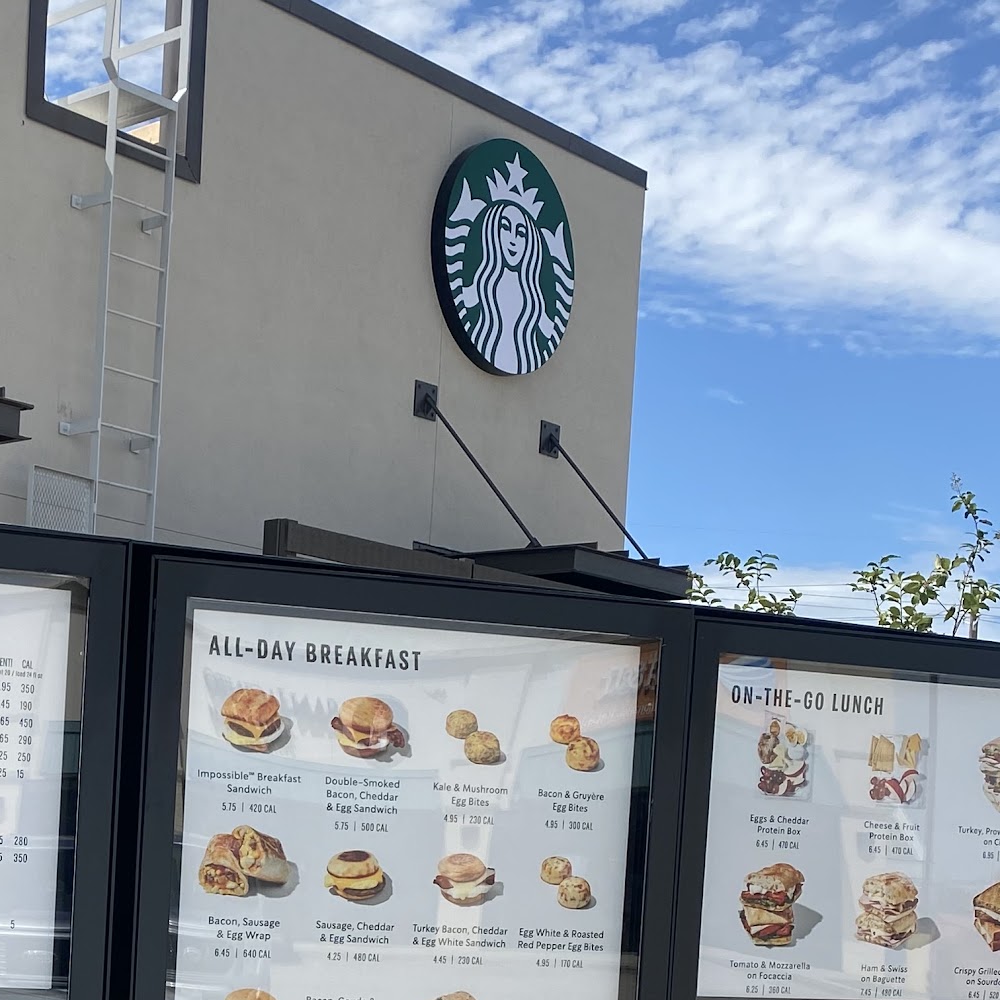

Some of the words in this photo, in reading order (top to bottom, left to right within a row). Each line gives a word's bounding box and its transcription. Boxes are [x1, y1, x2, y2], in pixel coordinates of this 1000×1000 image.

[208, 634, 296, 661] ALL-DAY
[306, 642, 421, 671] BREAKFAST
[20, 683, 35, 694] 350
[731, 684, 824, 711] ON-THE-GO
[832, 693, 884, 716] LUNCH
[257, 772, 301, 784] Breakfast
[325, 776, 400, 789] Double-Smoked
[227, 783, 272, 795] Sandwich
[326, 789, 357, 801] Bacon,
[359, 791, 399, 802] Cheddar
[538, 788, 563, 798] Bacon
[564, 790, 571, 799] &
[572, 790, 605, 802] Gruyère
[326, 802, 333, 812] &
[335, 802, 352, 814] Egg
[353, 803, 398, 815] Sandwich
[552, 802, 567, 814] Egg
[568, 803, 588, 813] Bites
[334, 820, 349, 831] 5.75
[360, 822, 375, 832] 500
[375, 823, 388, 833] CAL
[864, 820, 893, 830] Cheese
[894, 822, 900, 830] &
[902, 822, 920, 832] Fruit
[869, 831, 898, 841] Protein
[899, 833, 914, 842] Box
[208, 916, 240, 927] Bacon,
[242, 917, 280, 930] Sausage
[216, 929, 224, 939] &
[226, 930, 243, 941] Egg
[245, 930, 271, 942] Wrap
[860, 964, 879, 972] Ham
[880, 964, 886, 973] &
[887, 964, 908, 973] Swiss
[872, 975, 906, 985] Baguette
